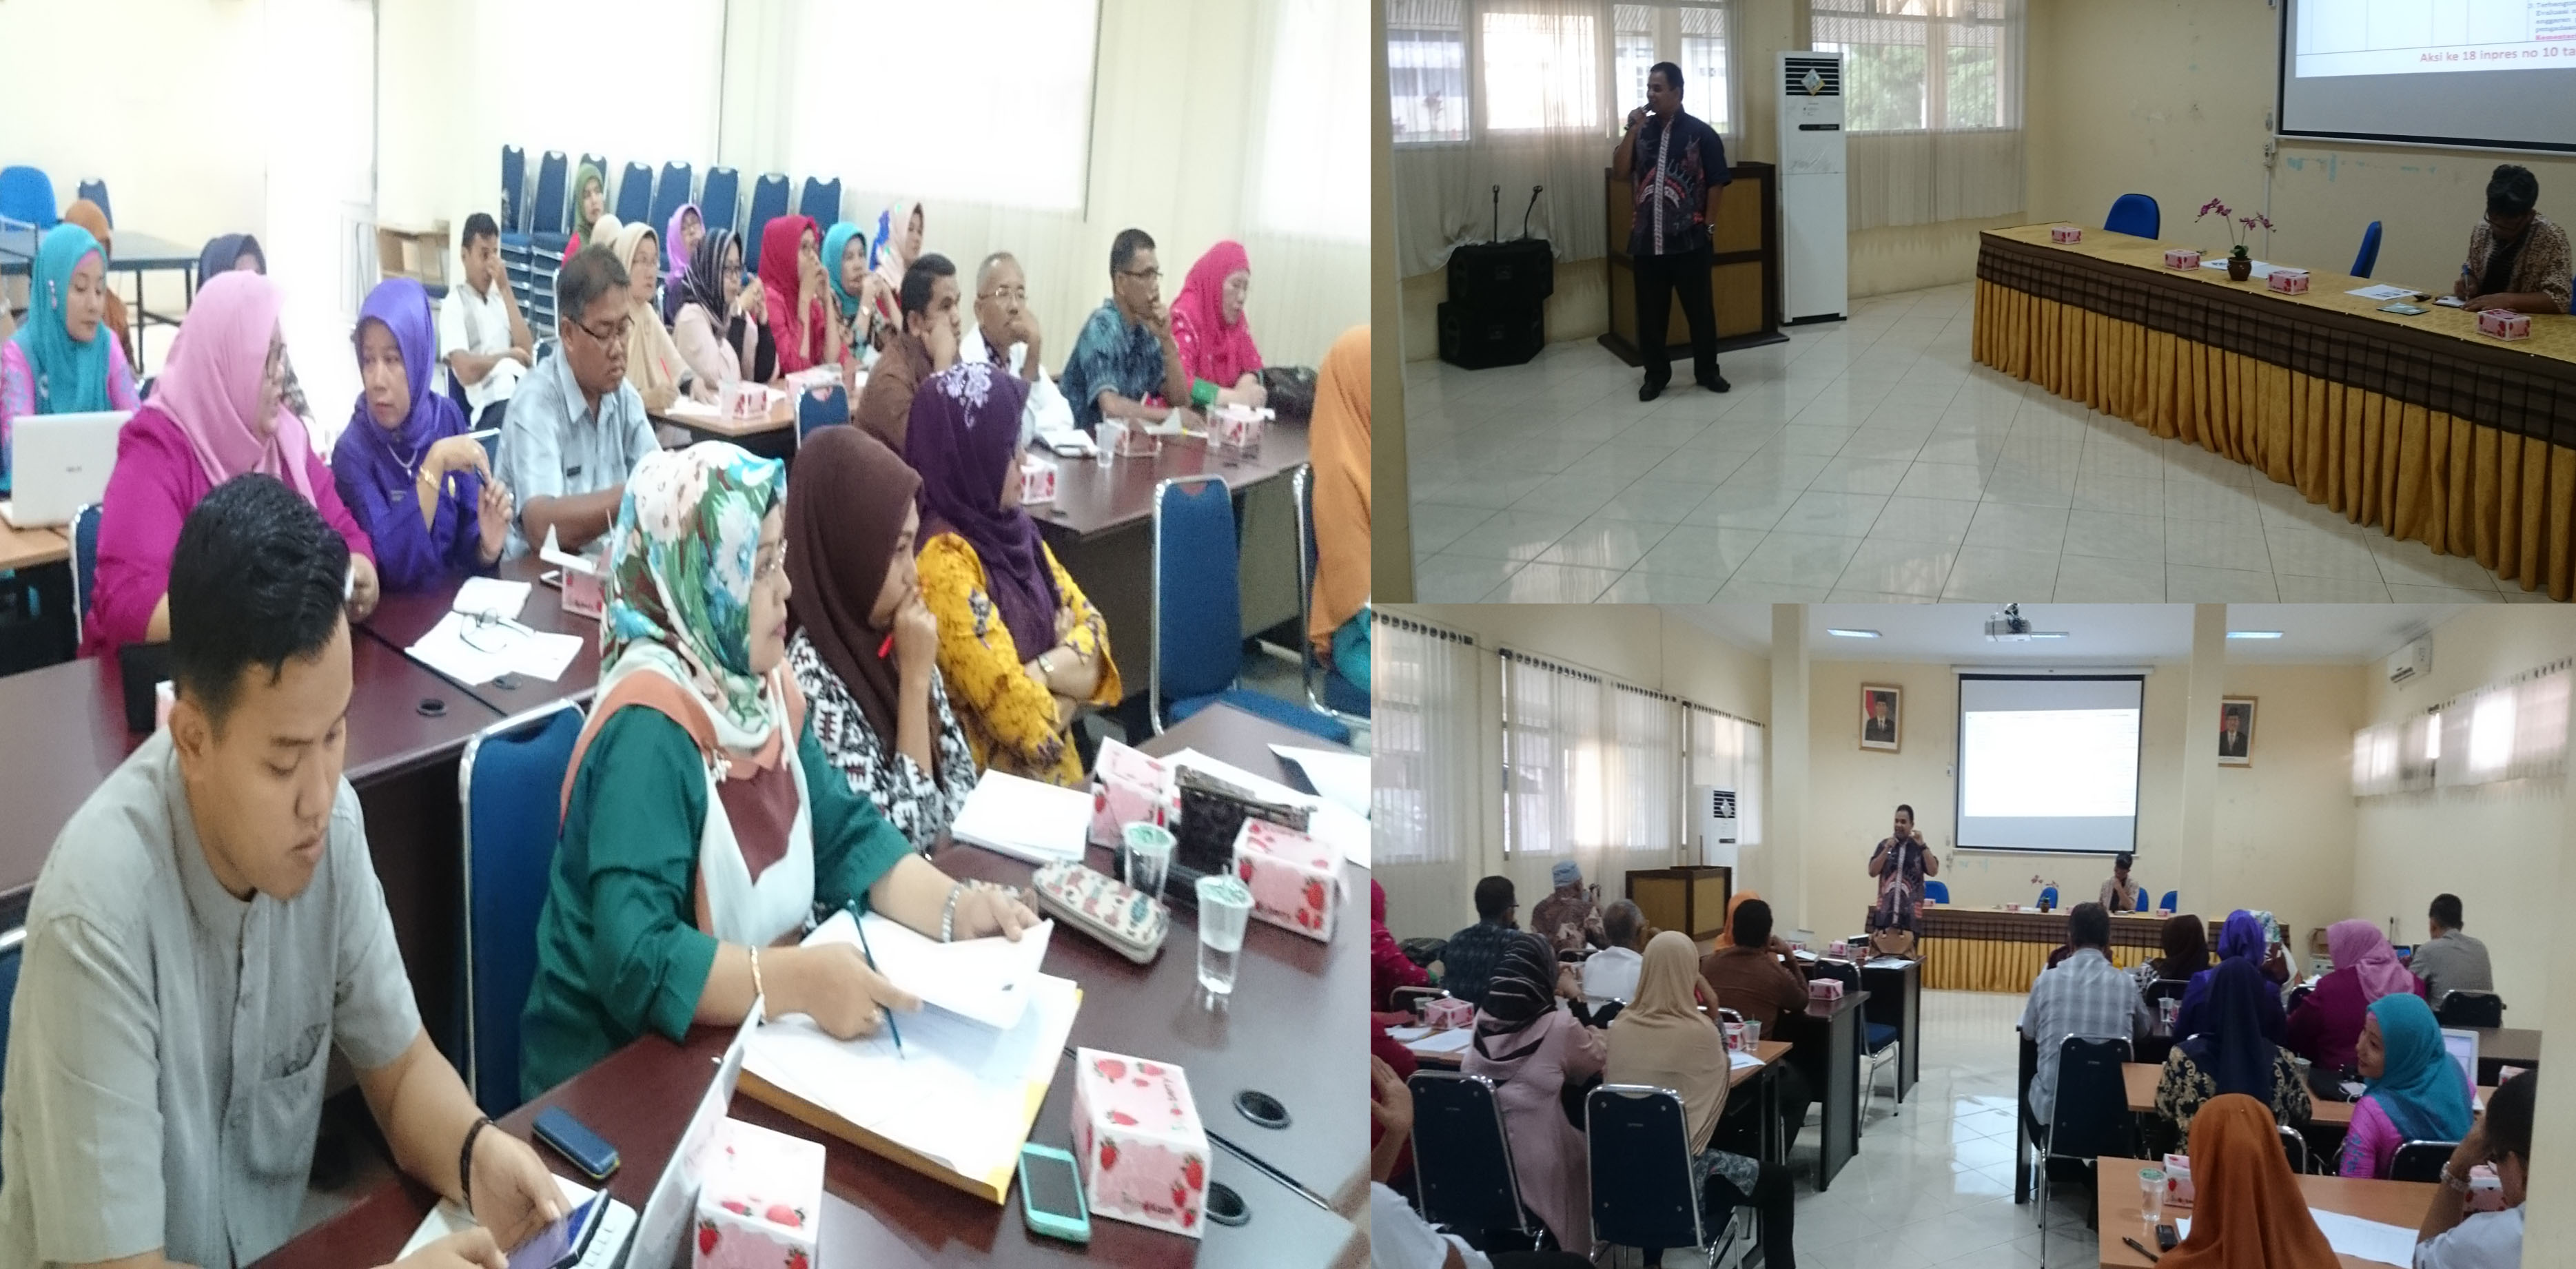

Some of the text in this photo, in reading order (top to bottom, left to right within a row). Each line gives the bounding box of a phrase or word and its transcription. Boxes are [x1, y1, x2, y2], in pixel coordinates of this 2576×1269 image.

[2420, 52, 2442, 62] Aksi
[2446, 52, 2458, 61] ke
[2463, 51, 2475, 60] 18
[2480, 50, 2517, 61] inpres
[2522, 50, 2537, 58] no
[2543, 47, 2558, 57] 10
